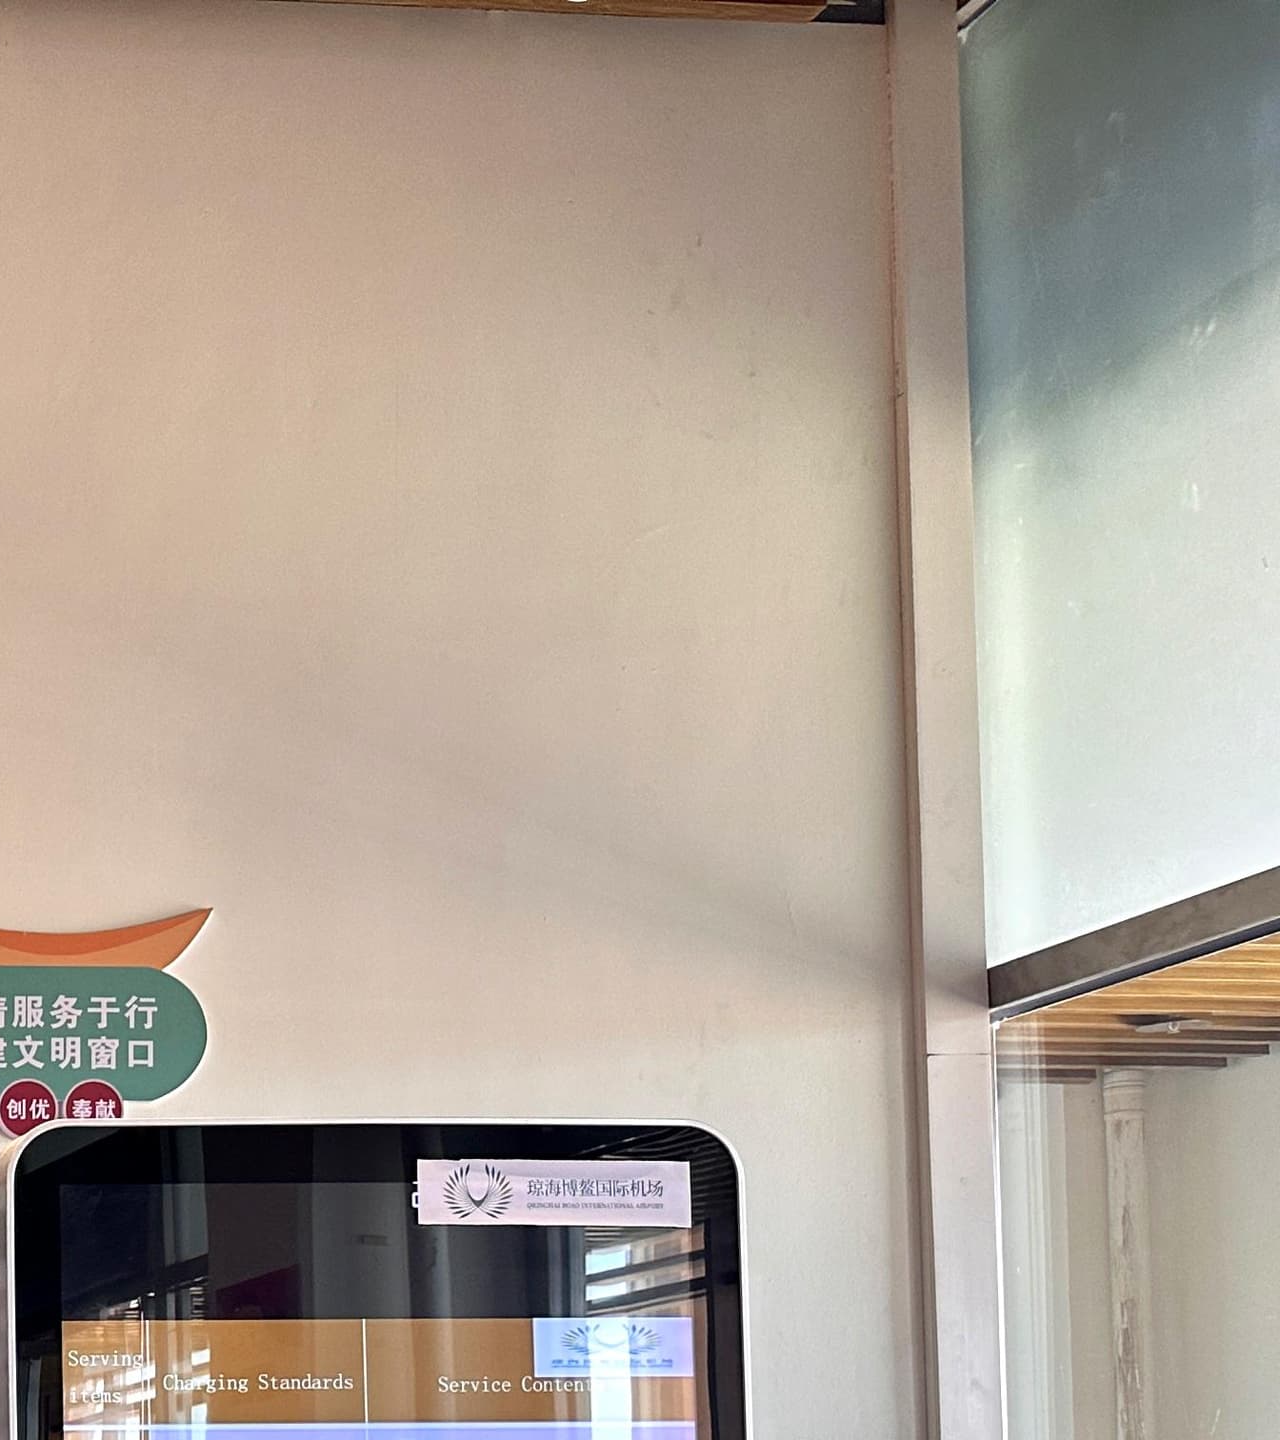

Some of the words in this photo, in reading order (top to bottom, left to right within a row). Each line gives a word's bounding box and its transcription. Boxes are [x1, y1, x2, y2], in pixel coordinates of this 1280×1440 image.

[6, 1099, 50, 1120] 创优
[71, 1099, 116, 1119] 奉献
[527, 1179, 663, 1197] 琼海博鳌国际机场
[68, 1351, 143, 1368] Serving
[258, 1375, 353, 1390] Standards
[438, 1376, 511, 1393] Service
